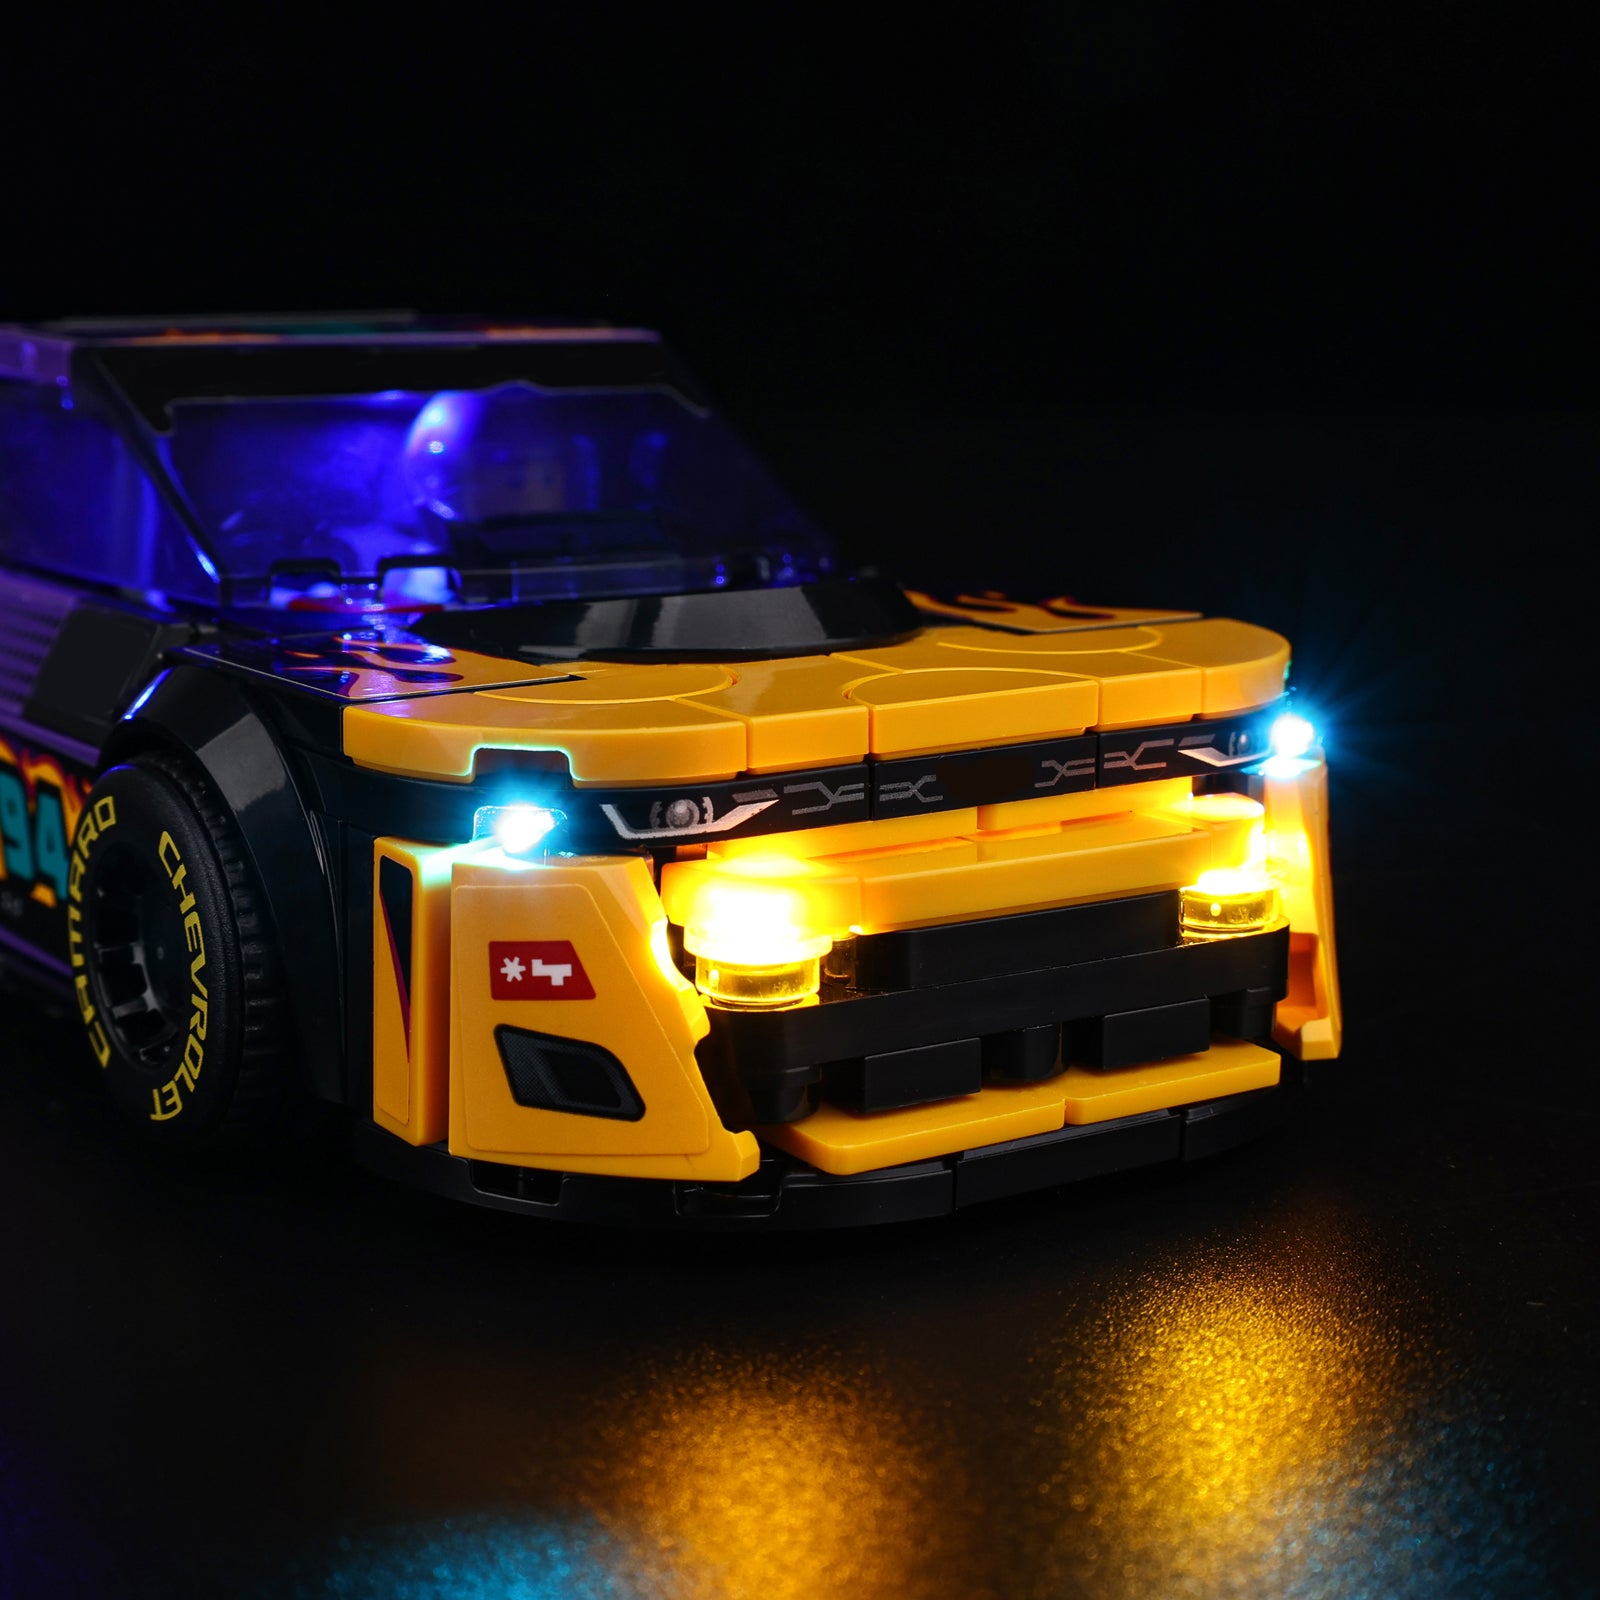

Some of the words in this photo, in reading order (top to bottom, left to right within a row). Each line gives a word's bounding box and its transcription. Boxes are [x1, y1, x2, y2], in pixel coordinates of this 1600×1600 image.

[0, 769, 69, 902] 94
[67, 795, 117, 1069] CAMARO
[150, 830, 209, 1121] CHEVROLET
